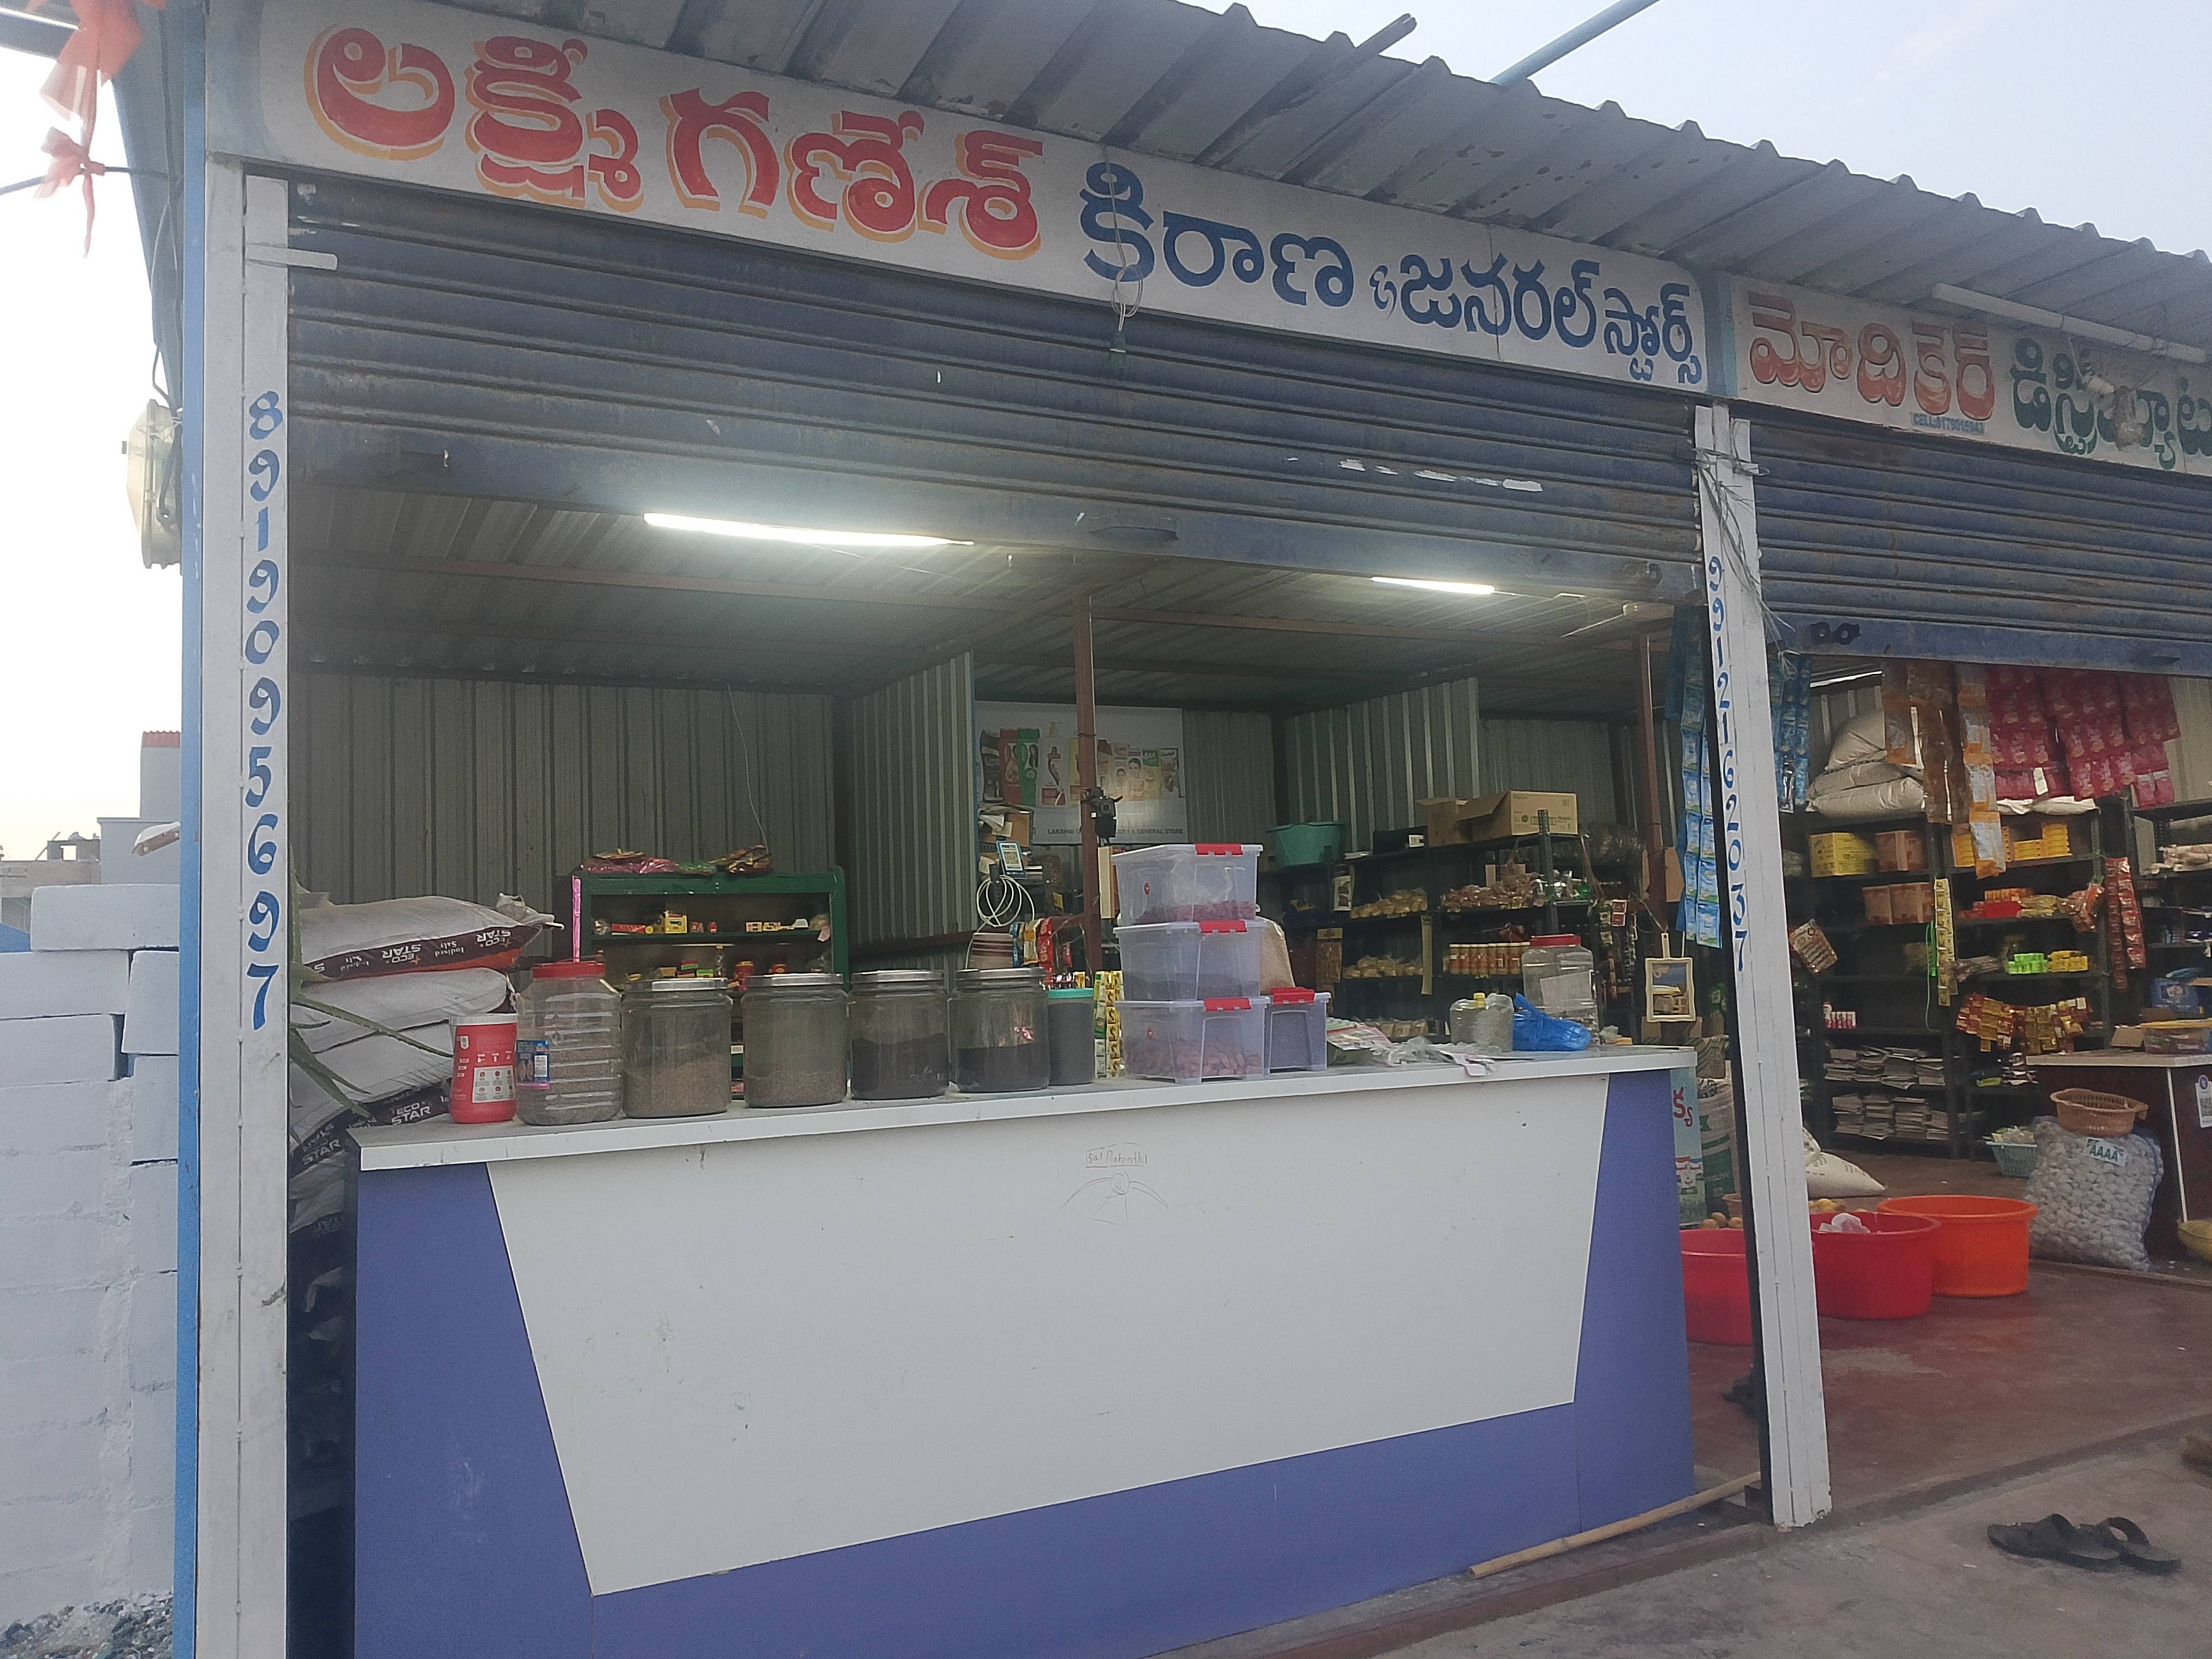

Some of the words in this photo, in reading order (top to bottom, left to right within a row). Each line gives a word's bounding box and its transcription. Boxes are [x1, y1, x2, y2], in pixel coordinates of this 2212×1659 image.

[245, 390, 283, 1030] 8919095697
[1709, 556, 1748, 972] 9912162037
[476, 929, 511, 942] STAR
[382, 944, 422, 959] STAR
[392, 953, 415, 963] ECO
[391, 1105, 431, 1125] STAR
[397, 1102, 420, 1115] ECO
[302, 1138, 341, 1165] STAR
